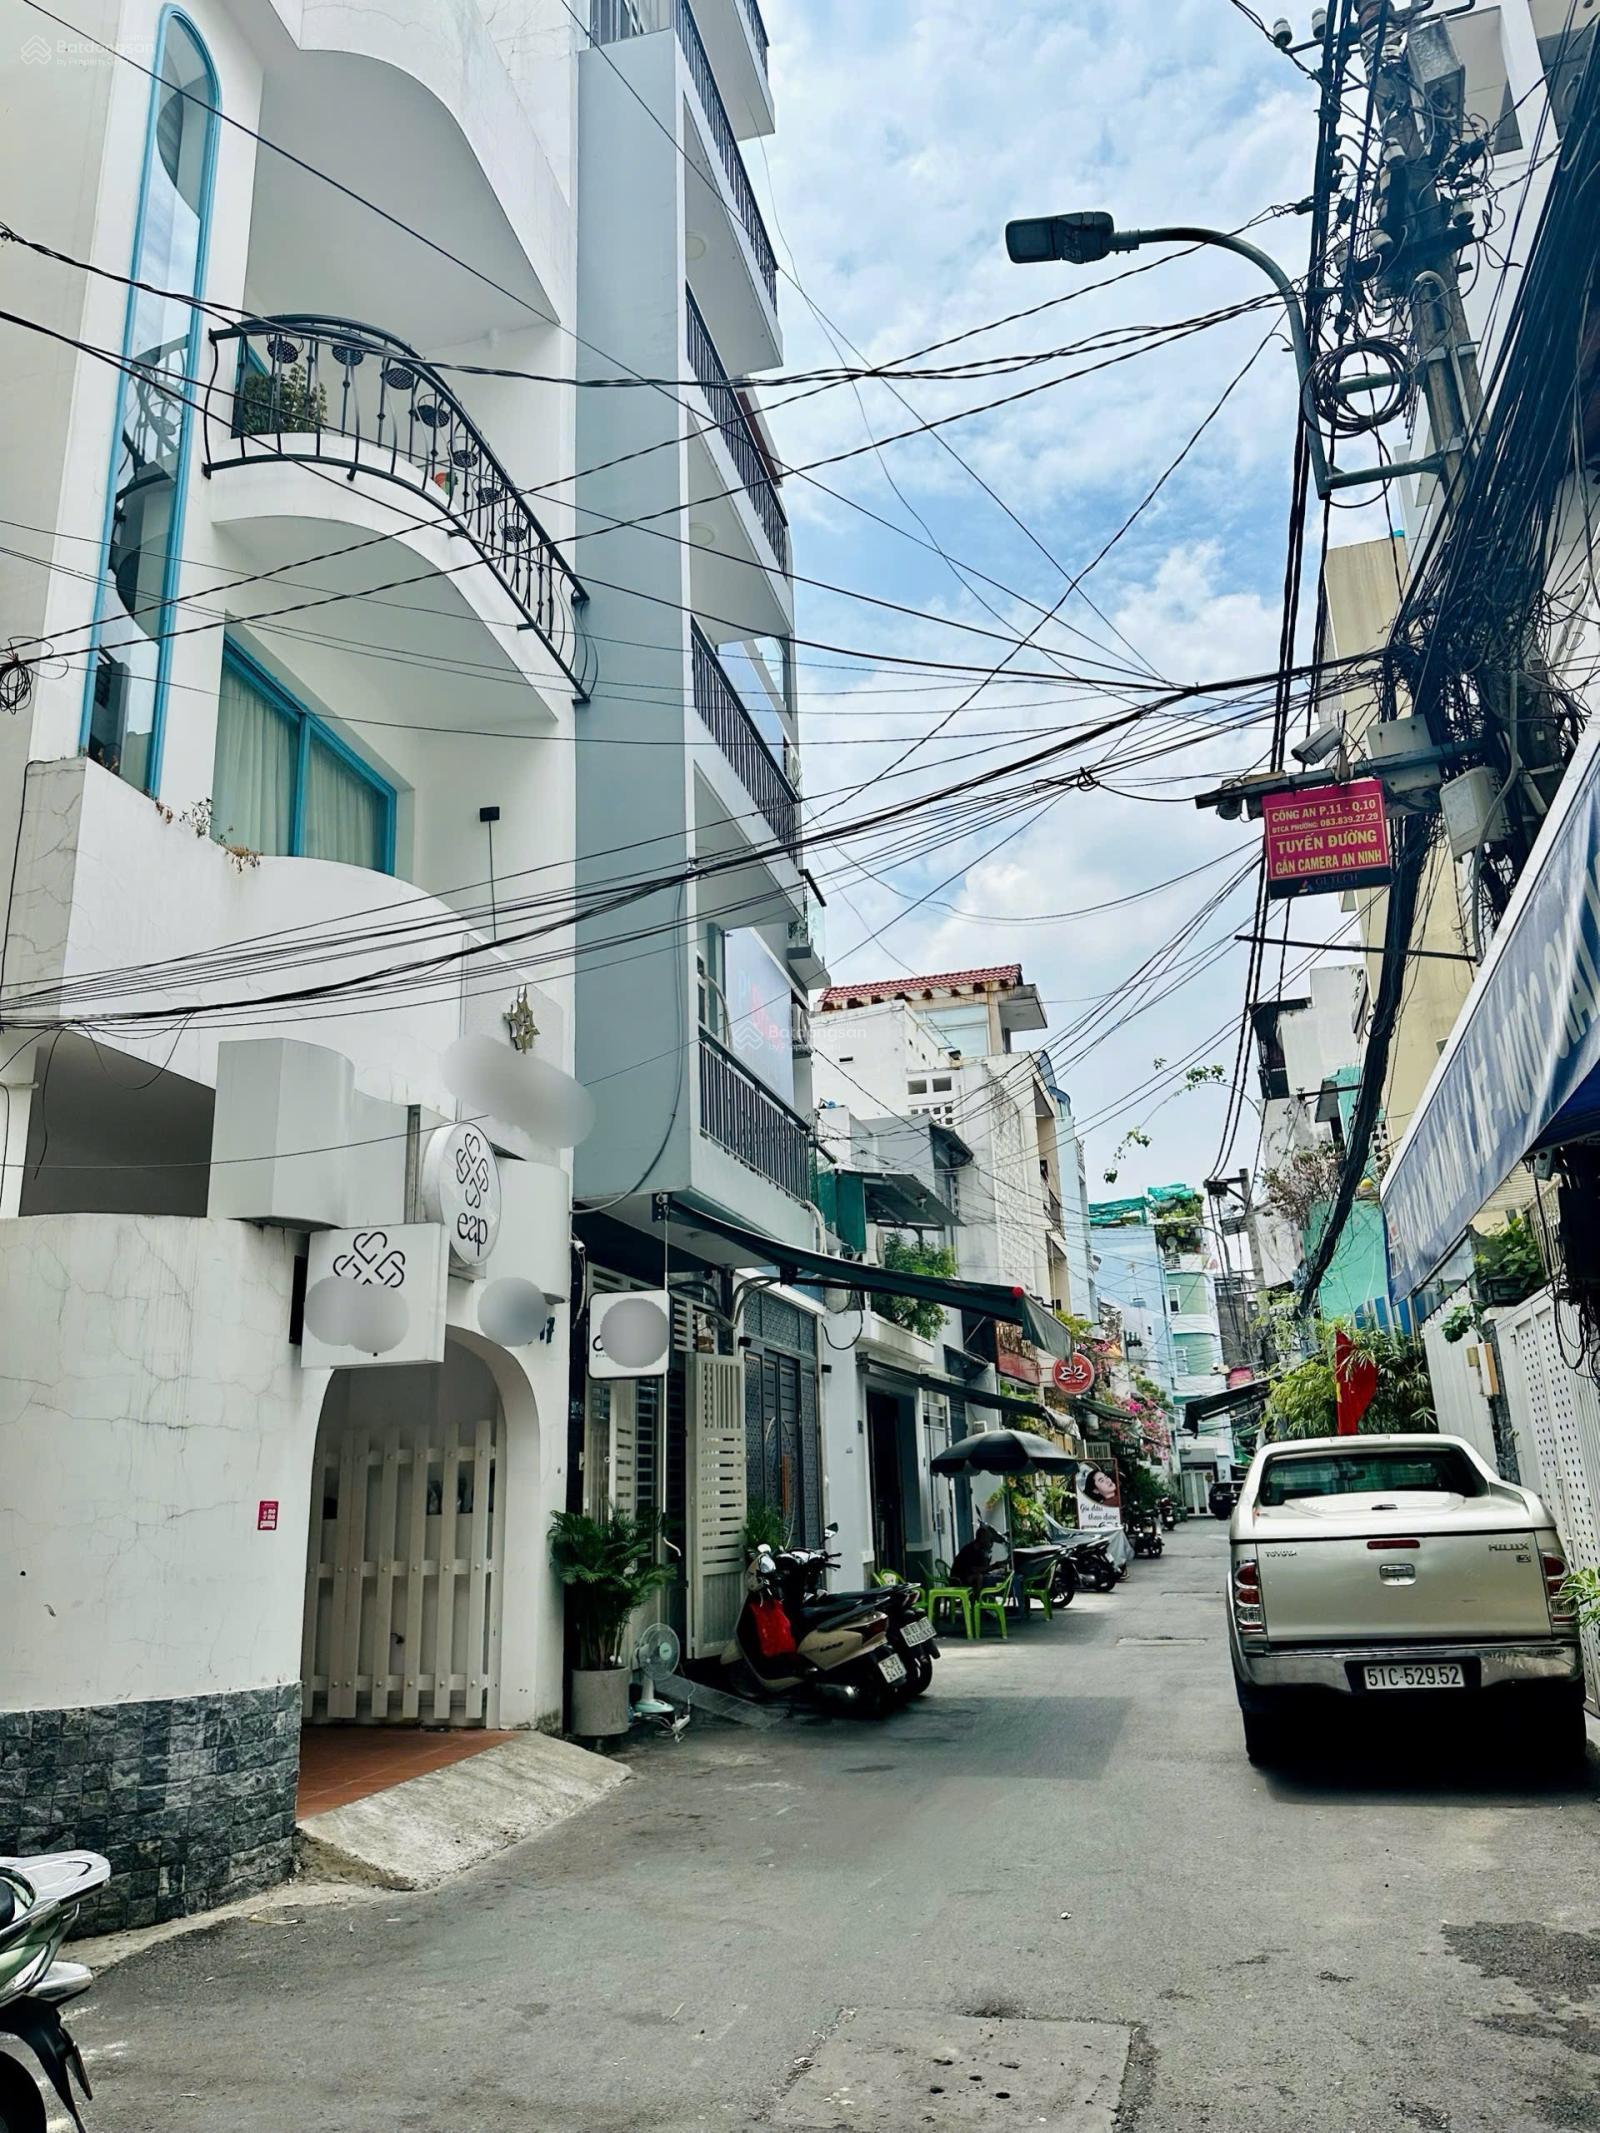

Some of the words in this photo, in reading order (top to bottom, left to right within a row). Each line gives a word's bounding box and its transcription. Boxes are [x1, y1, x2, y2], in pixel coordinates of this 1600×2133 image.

[1272, 809, 1300, 823] CÔNG
[1302, 807, 1316, 818] AN
[1319, 804, 1343, 816] P.11
[1352, 799, 1376, 813] Q.10
[1276, 832, 1324, 855] TUYẾN
[1327, 828, 1378, 848] ĐƯỜNG
[1298, 854, 1340, 873] CAMERA
[1341, 852, 1356, 867] AN
[1358, 849, 1383, 865] NINH
[457, 1212, 488, 1257] eap
[1366, 1665, 1461, 1687] 51C-529.52
